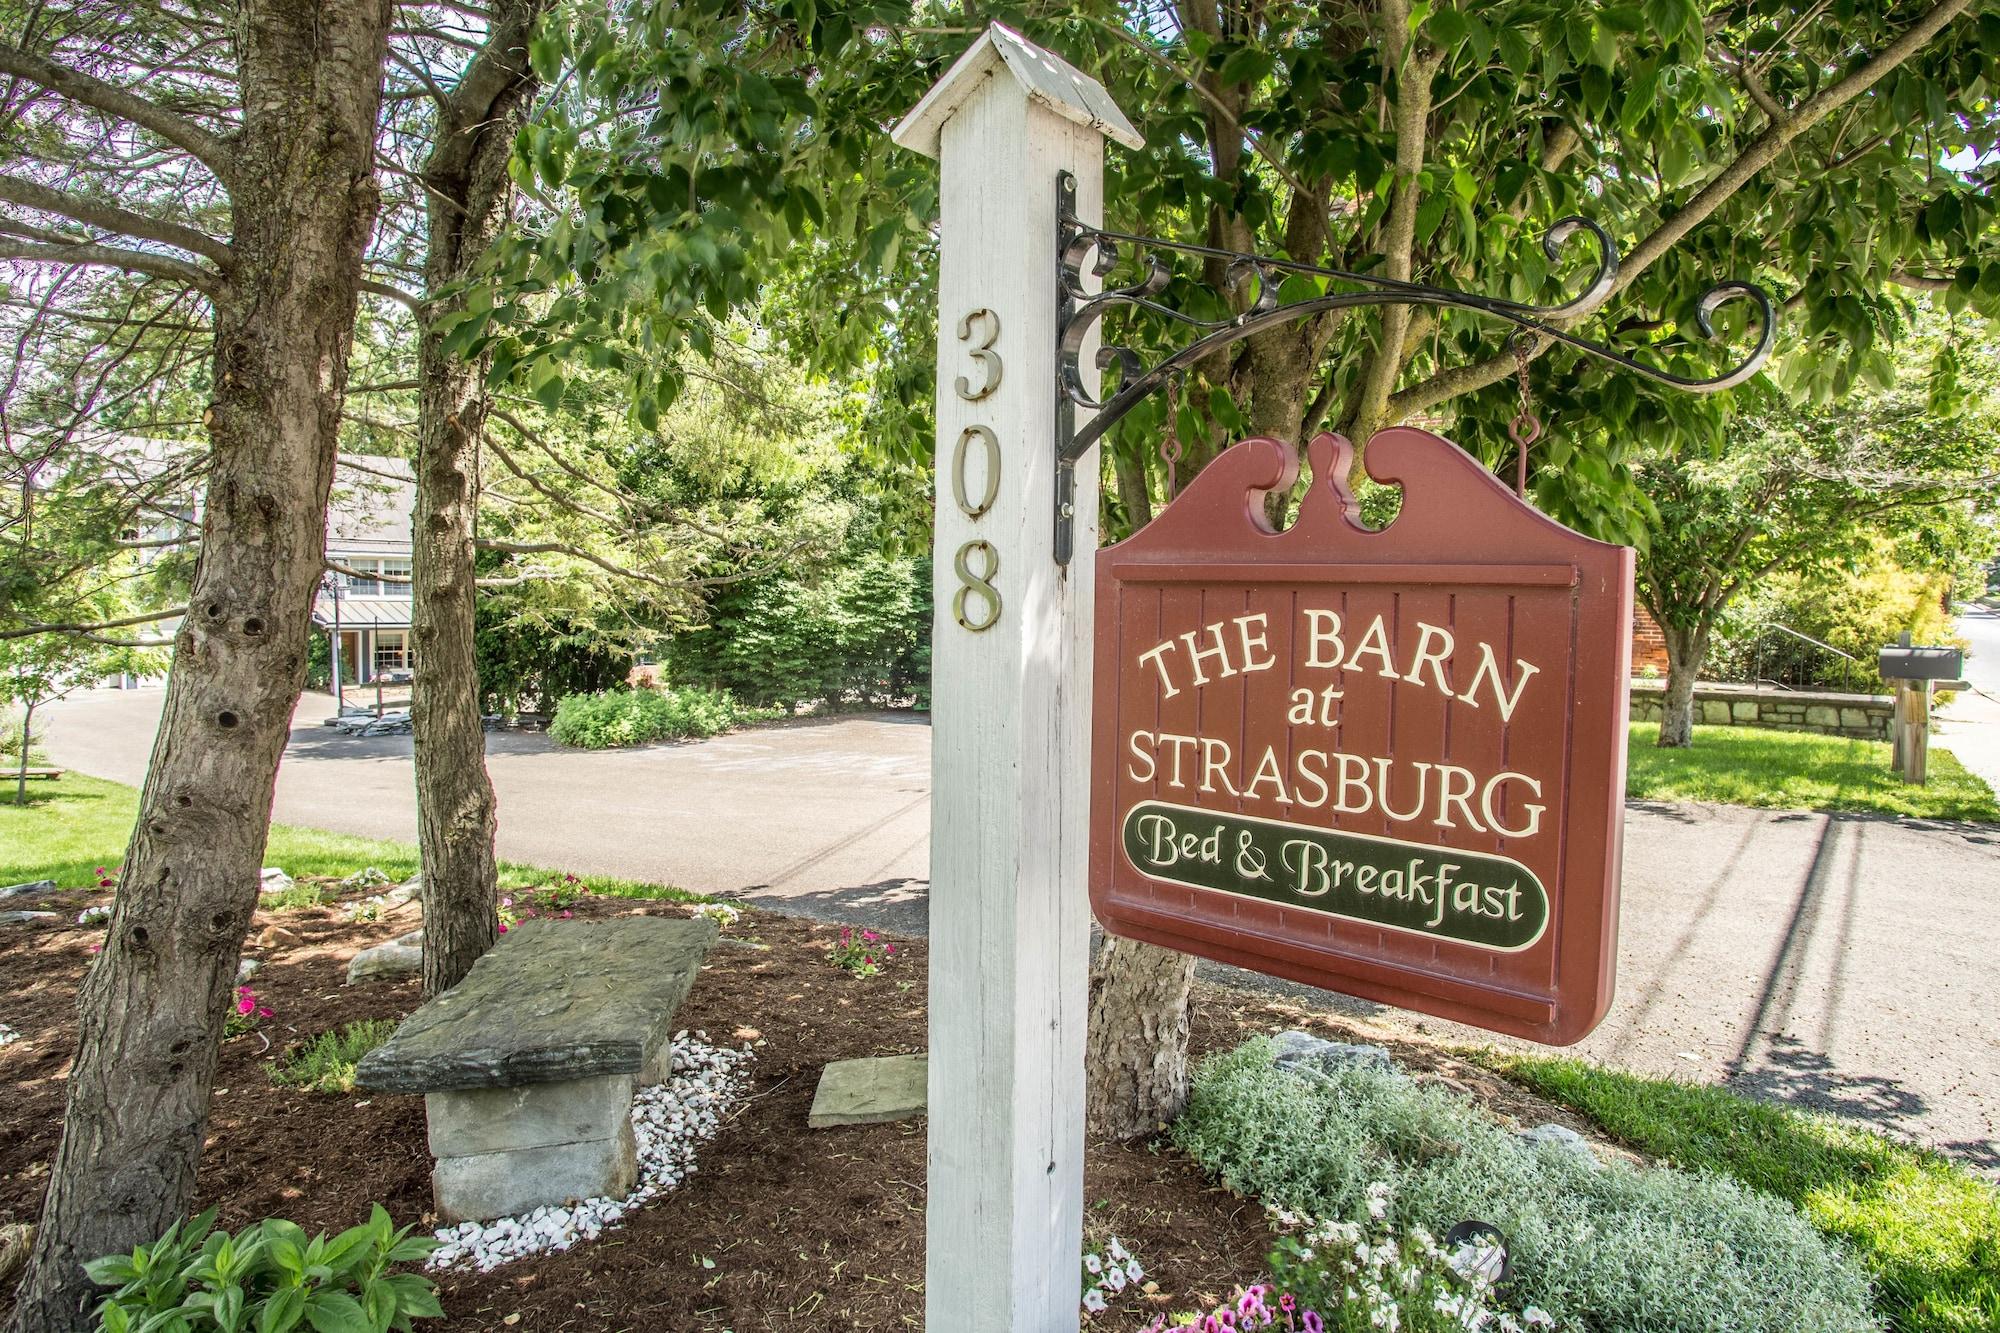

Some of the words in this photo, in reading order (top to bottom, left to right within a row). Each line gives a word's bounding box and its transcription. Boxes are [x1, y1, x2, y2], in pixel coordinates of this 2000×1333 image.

[952, 308, 1003, 631] 308
[1138, 612, 1276, 701] THE
[1303, 608, 1541, 723] BARN
[1287, 685, 1345, 727] at
[1127, 729, 1547, 839] STRASBURG
[1137, 814, 1226, 866] Bed
[1234, 828, 1275, 883] &
[1279, 839, 1526, 928] Breakfast
